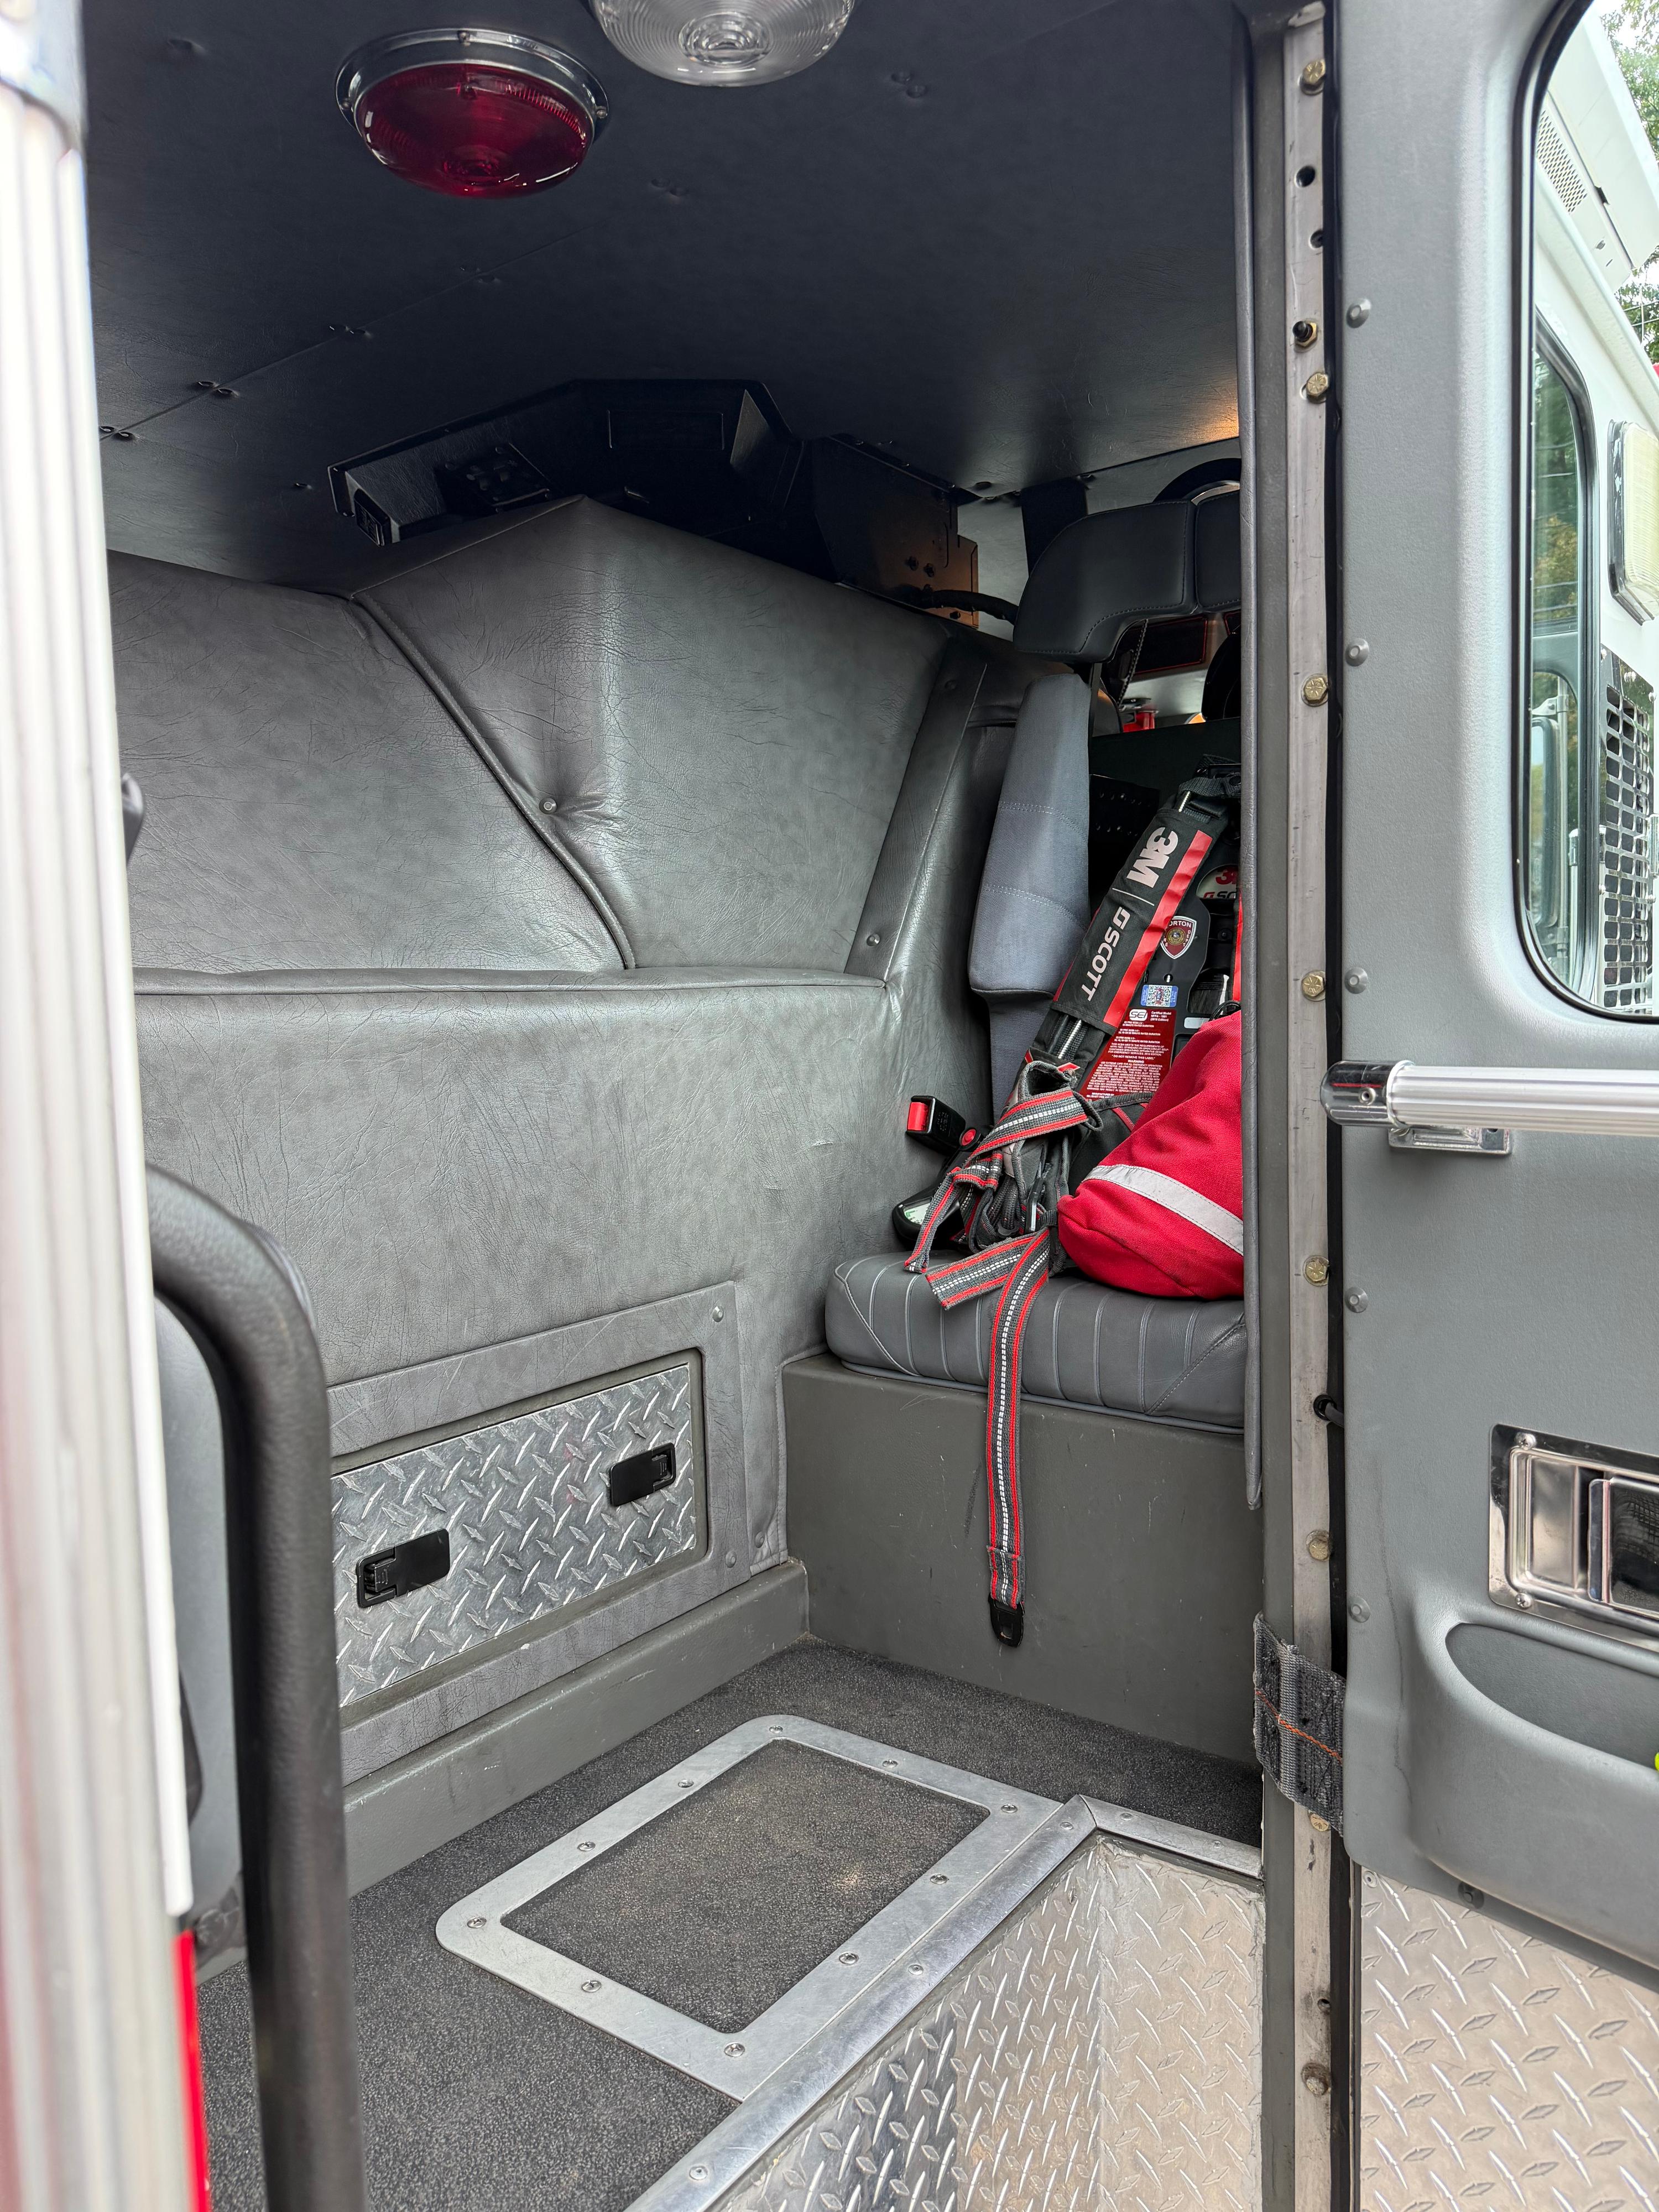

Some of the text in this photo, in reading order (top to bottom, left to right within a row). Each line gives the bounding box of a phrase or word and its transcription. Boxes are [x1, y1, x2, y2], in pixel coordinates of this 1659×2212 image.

[1126, 827, 1178, 888] 3M
[1215, 866, 1237, 885] 3
[1081, 926, 1120, 1001] SCOTT
